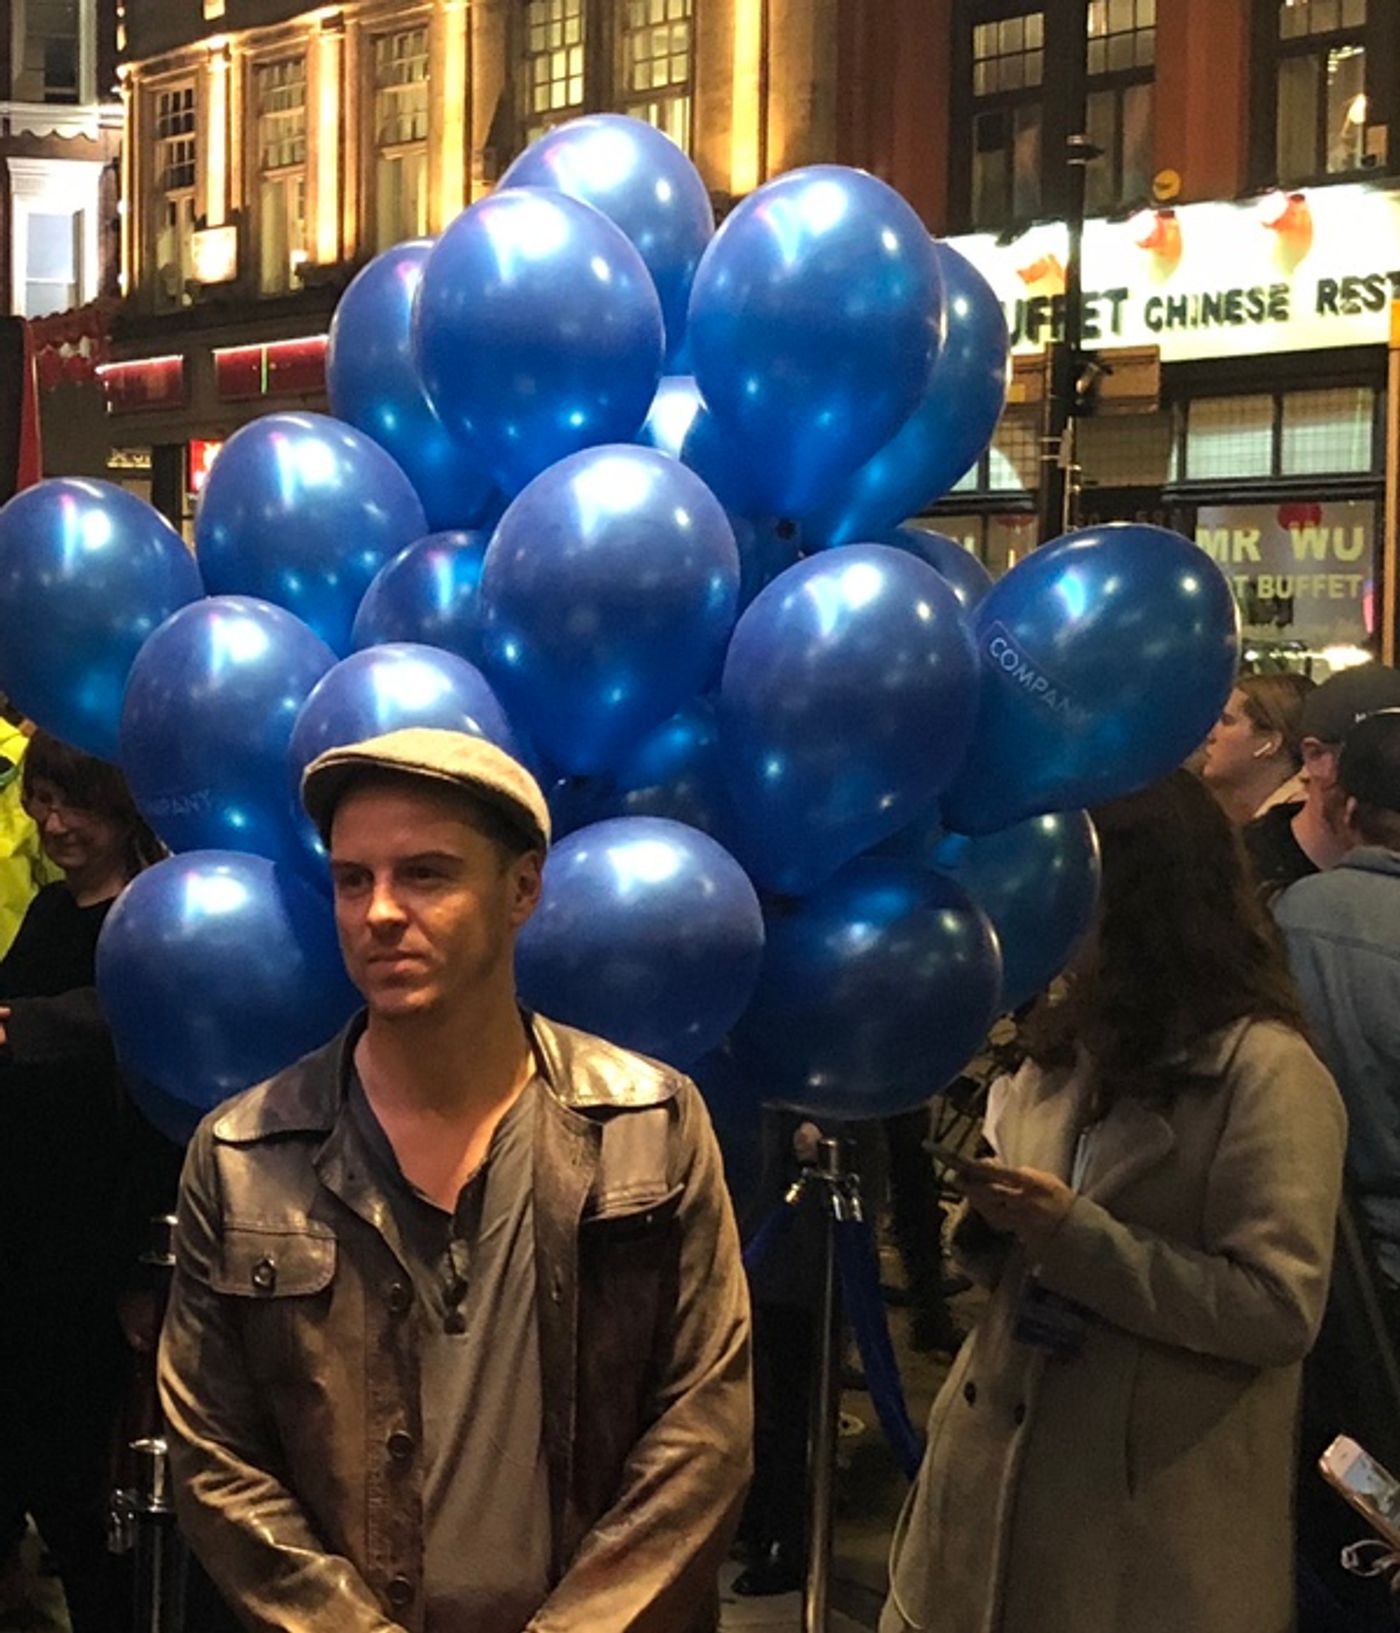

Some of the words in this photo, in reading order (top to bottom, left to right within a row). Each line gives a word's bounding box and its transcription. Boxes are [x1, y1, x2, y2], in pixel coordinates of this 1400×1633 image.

[1010, 288, 1128, 346] UFFET
[1143, 283, 1290, 333] CHINESE
[1196, 528, 1261, 562] MR
[1288, 520, 1364, 562] WU
[1257, 573, 1363, 599] BUFFET
